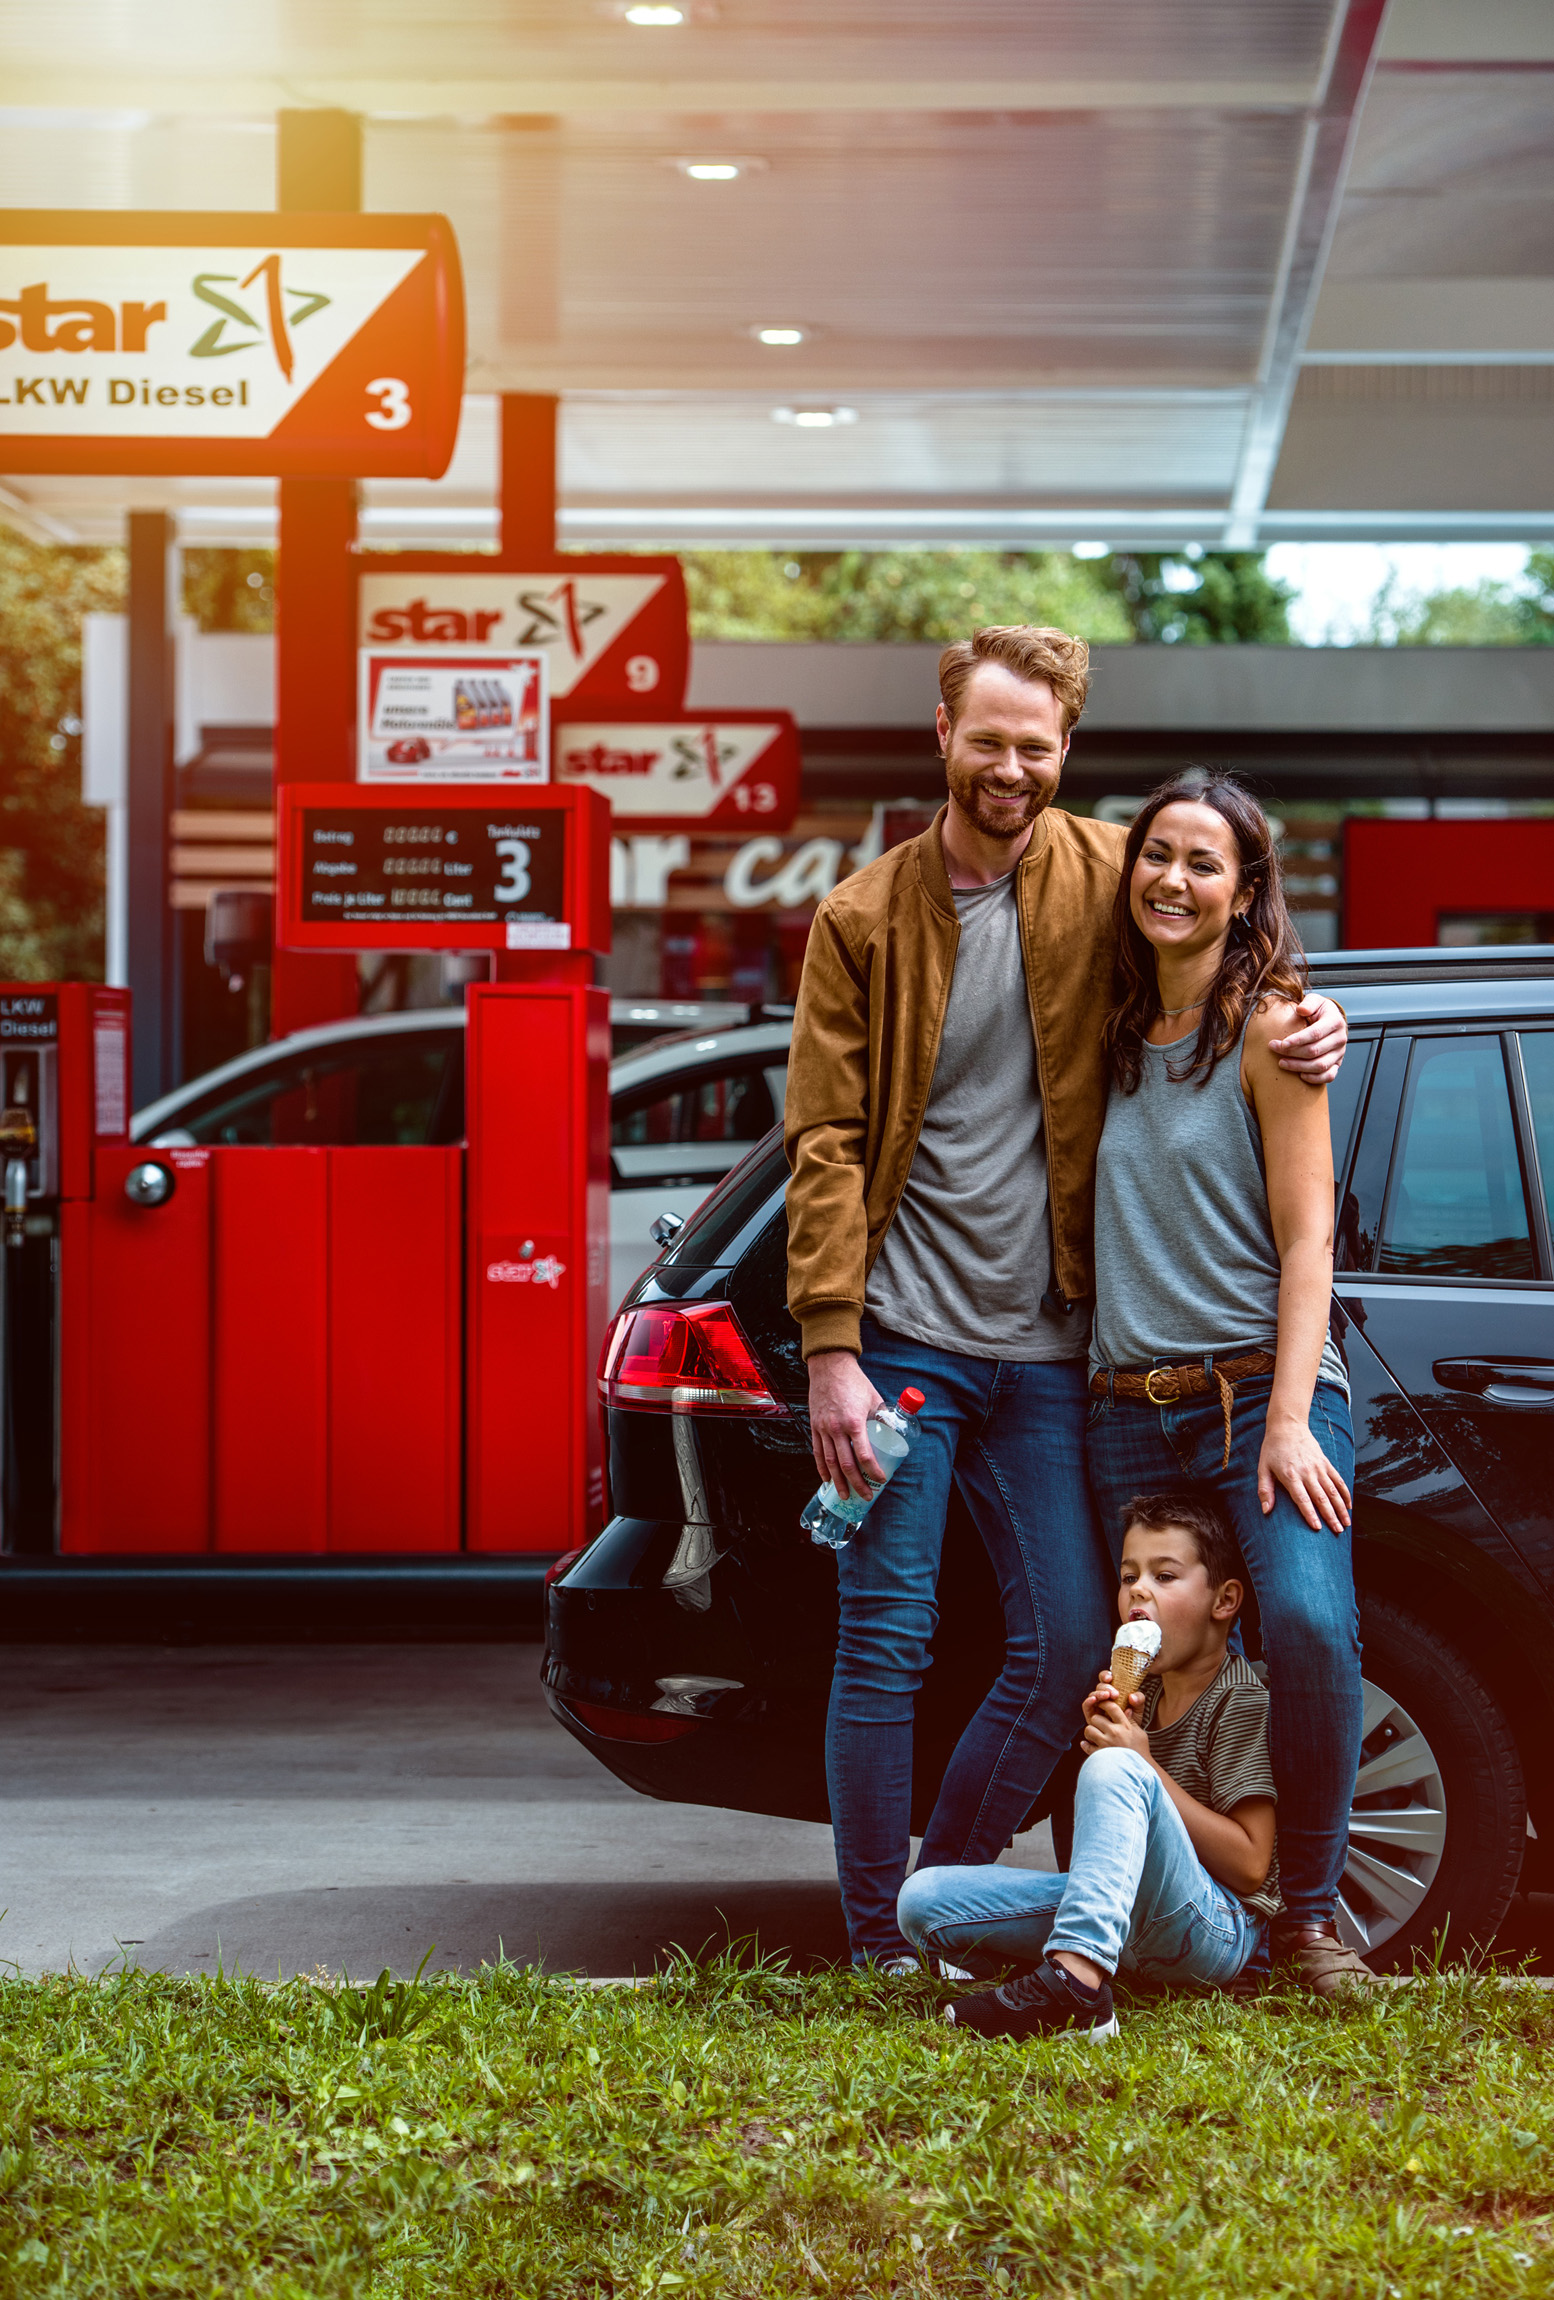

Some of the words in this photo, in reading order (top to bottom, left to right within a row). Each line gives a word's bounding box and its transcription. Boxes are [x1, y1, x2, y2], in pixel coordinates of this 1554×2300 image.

[108, 378, 249, 407] Diesel
[364, 377, 412, 431] 3
[367, 597, 504, 643] star
[625, 655, 660, 693] 9
[561, 742, 663, 778] star
[733, 783, 778, 813] 13
[494, 838, 532, 903] 3
[0, 998, 45, 1016] LKW
[0, 1018, 58, 1037] Diesel
